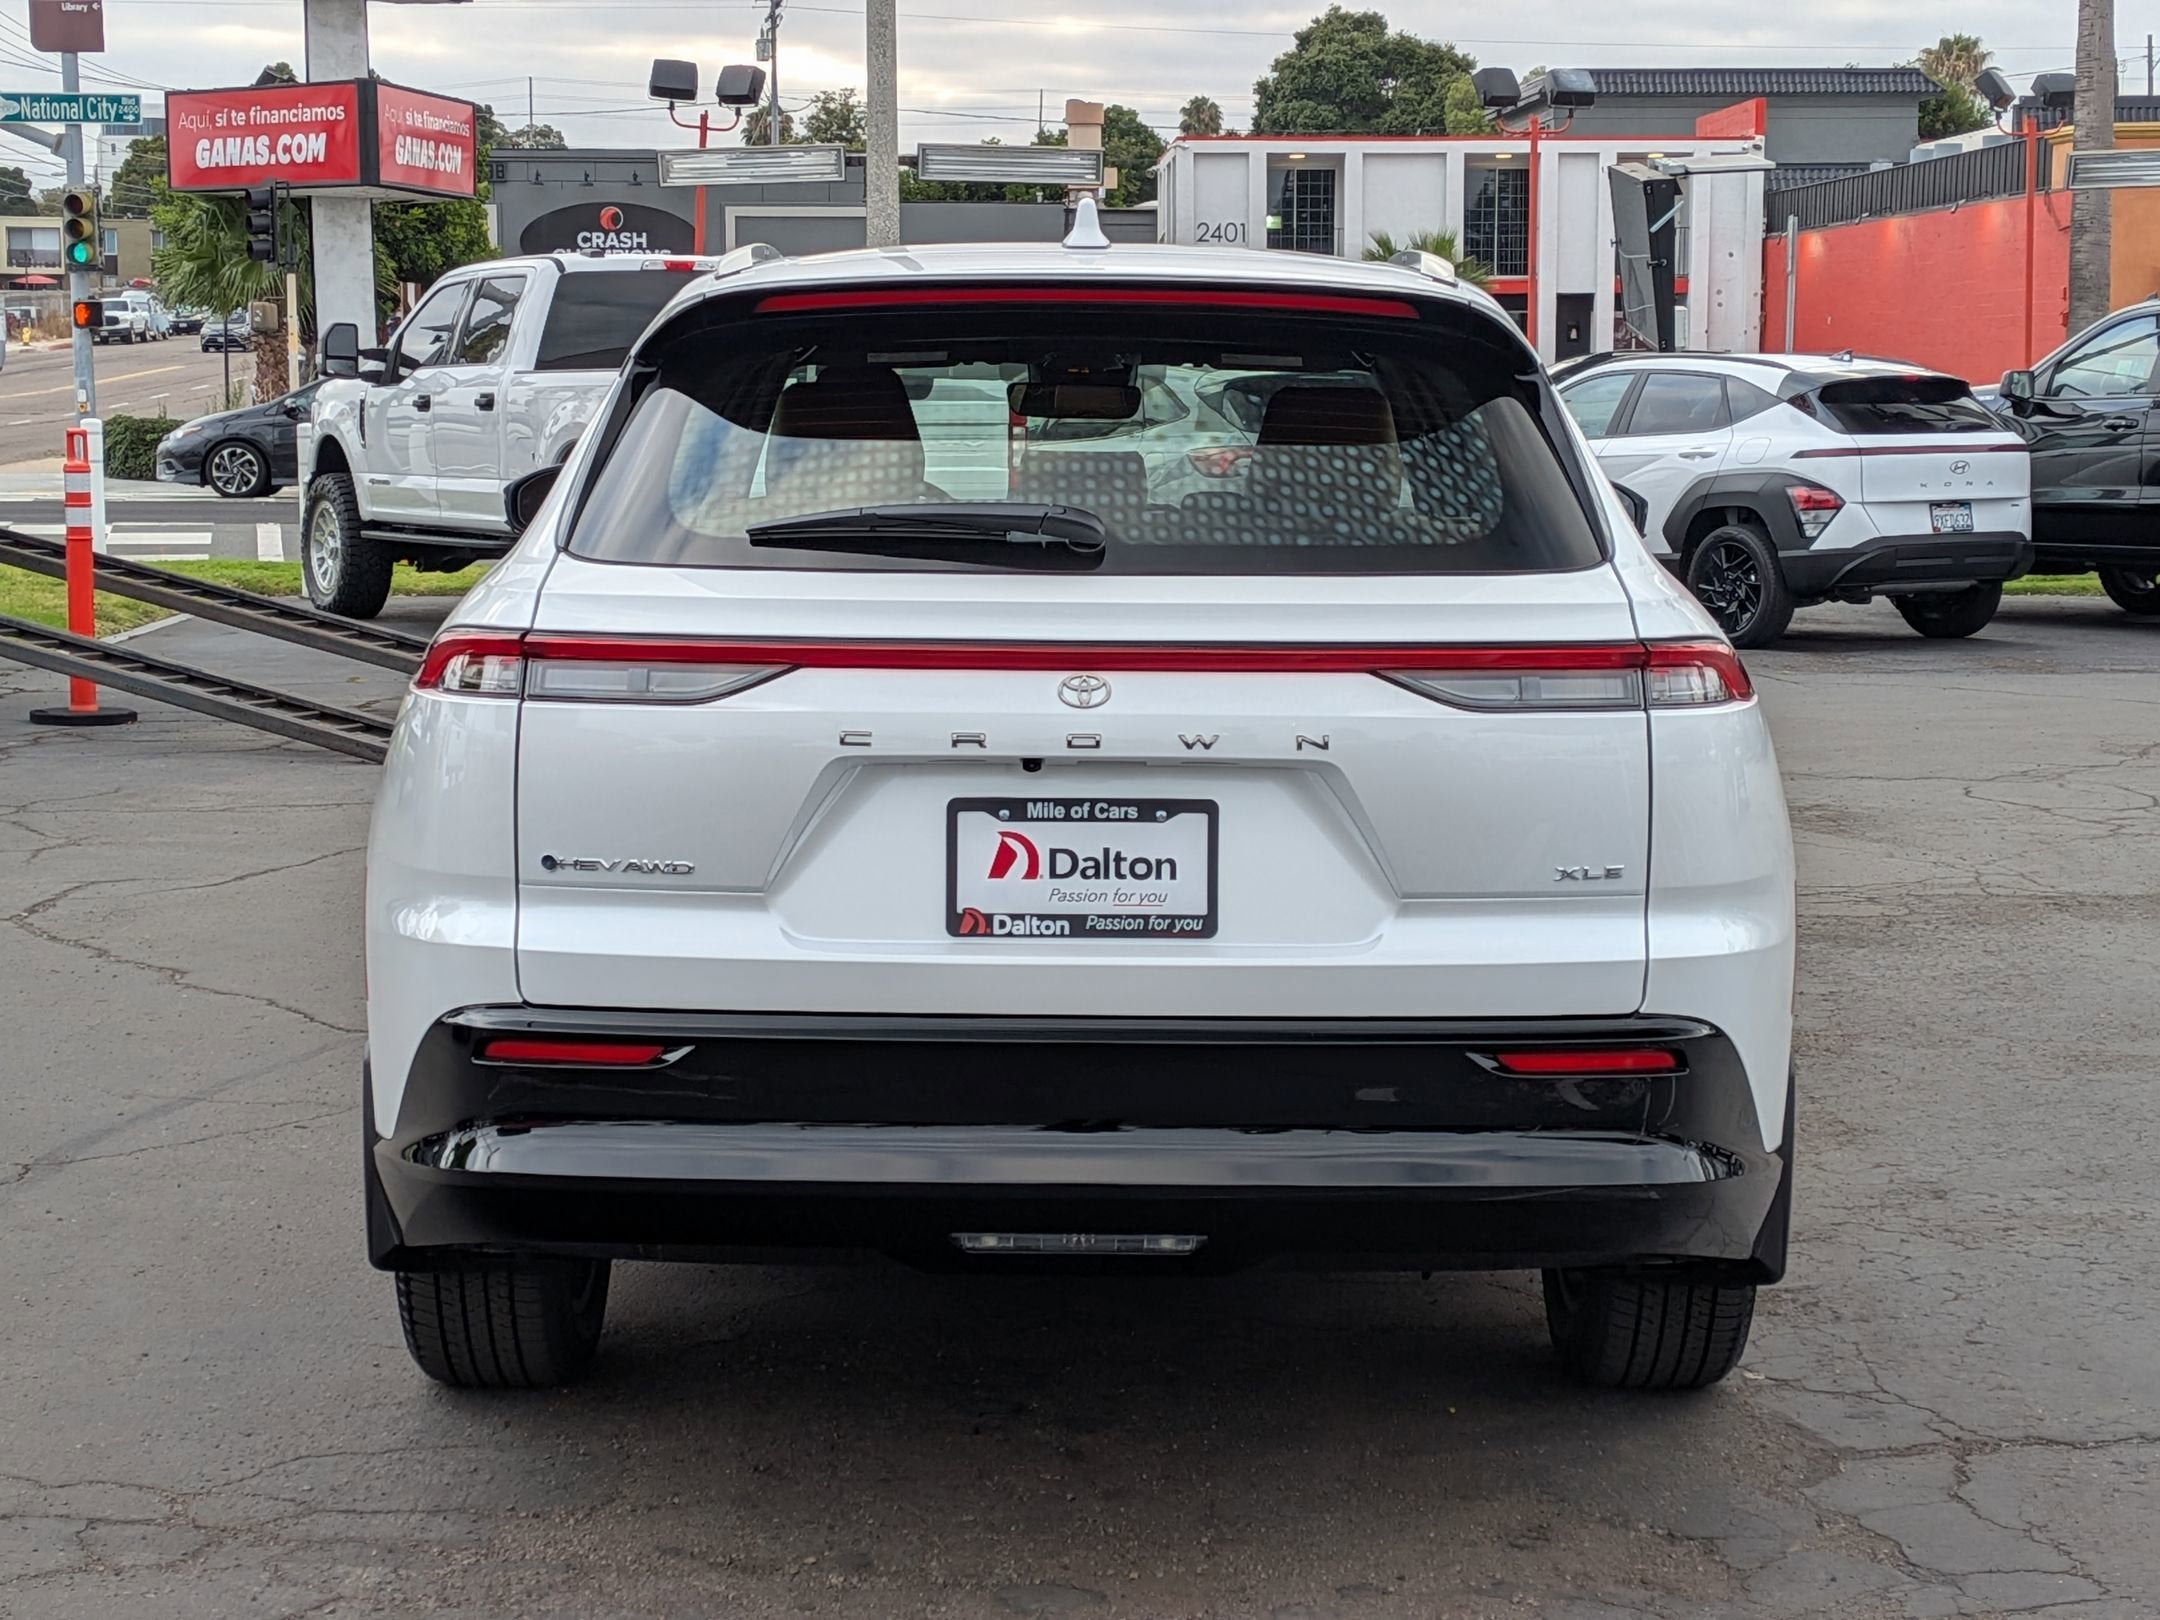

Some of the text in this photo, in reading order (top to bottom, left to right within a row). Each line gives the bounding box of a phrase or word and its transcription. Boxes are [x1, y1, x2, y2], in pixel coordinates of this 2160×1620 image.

[60, 2, 88, 12] Library
[20, 96, 83, 120] National
[87, 97, 118, 122] City
[118, 105, 139, 114] 2400
[178, 102, 345, 133] Aquí, sí te financiamos
[413, 110, 423, 128] te
[423, 110, 470, 137] financiamos
[195, 132, 327, 169] GANAS.COM
[395, 134, 462, 174] GANAS.COM
[576, 231, 648, 249] CRASH
[1196, 222, 1246, 243] 2401
[839, 730, 1329, 751] CROWN
[1027, 802, 1139, 819] Mile of Cars
[1049, 847, 1177, 881] Dalton
[1553, 864, 1625, 881] XLE
[1048, 888, 1168, 906] Passion for you
[993, 915, 1204, 935] Dalton Passion for you
